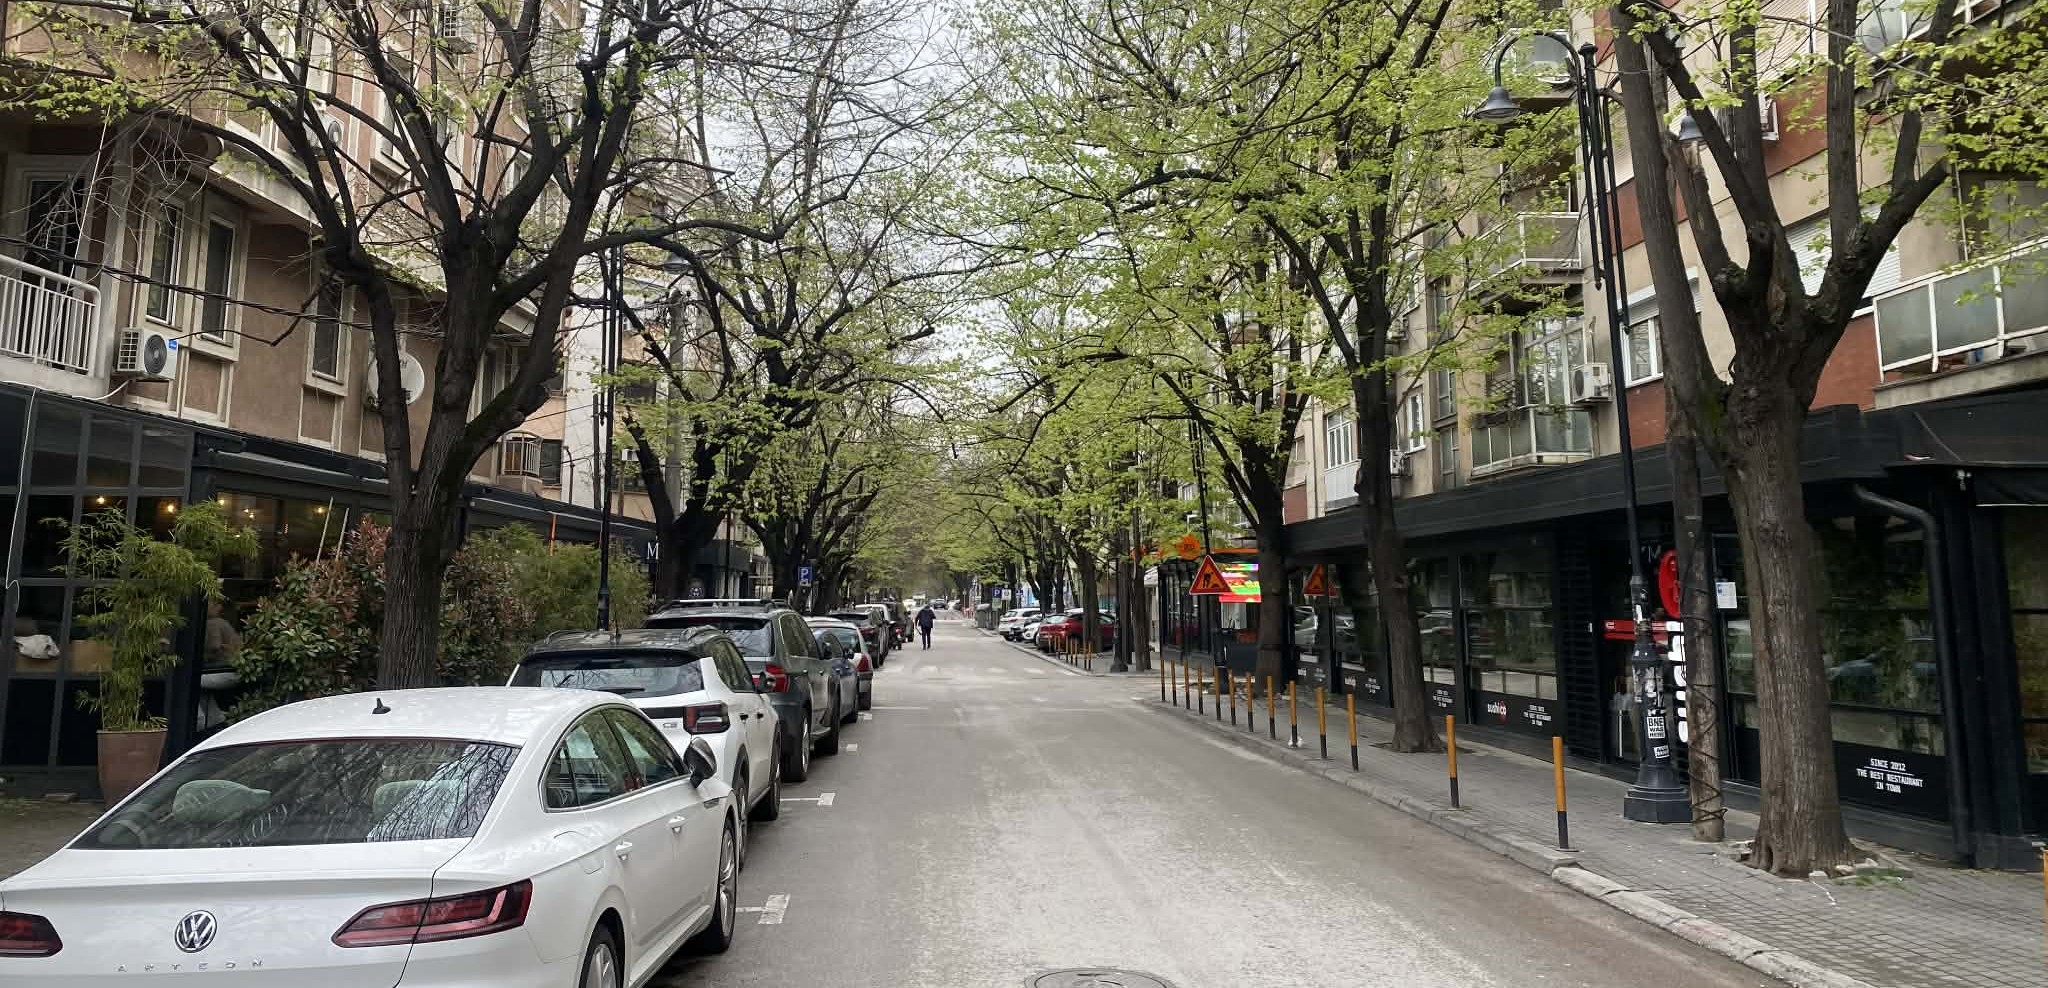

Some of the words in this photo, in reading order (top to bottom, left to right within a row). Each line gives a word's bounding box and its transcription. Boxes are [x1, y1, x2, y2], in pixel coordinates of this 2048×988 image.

[800, 568, 809, 581] P
[1870, 758, 1888, 768] SINCE
[1890, 761, 1906, 772] 2012
[1856, 768, 1868, 778] THE
[1869, 770, 1884, 780] BEST
[1886, 773, 1923, 787] RESTAURANT
[1875, 781, 1884, 790] IN
